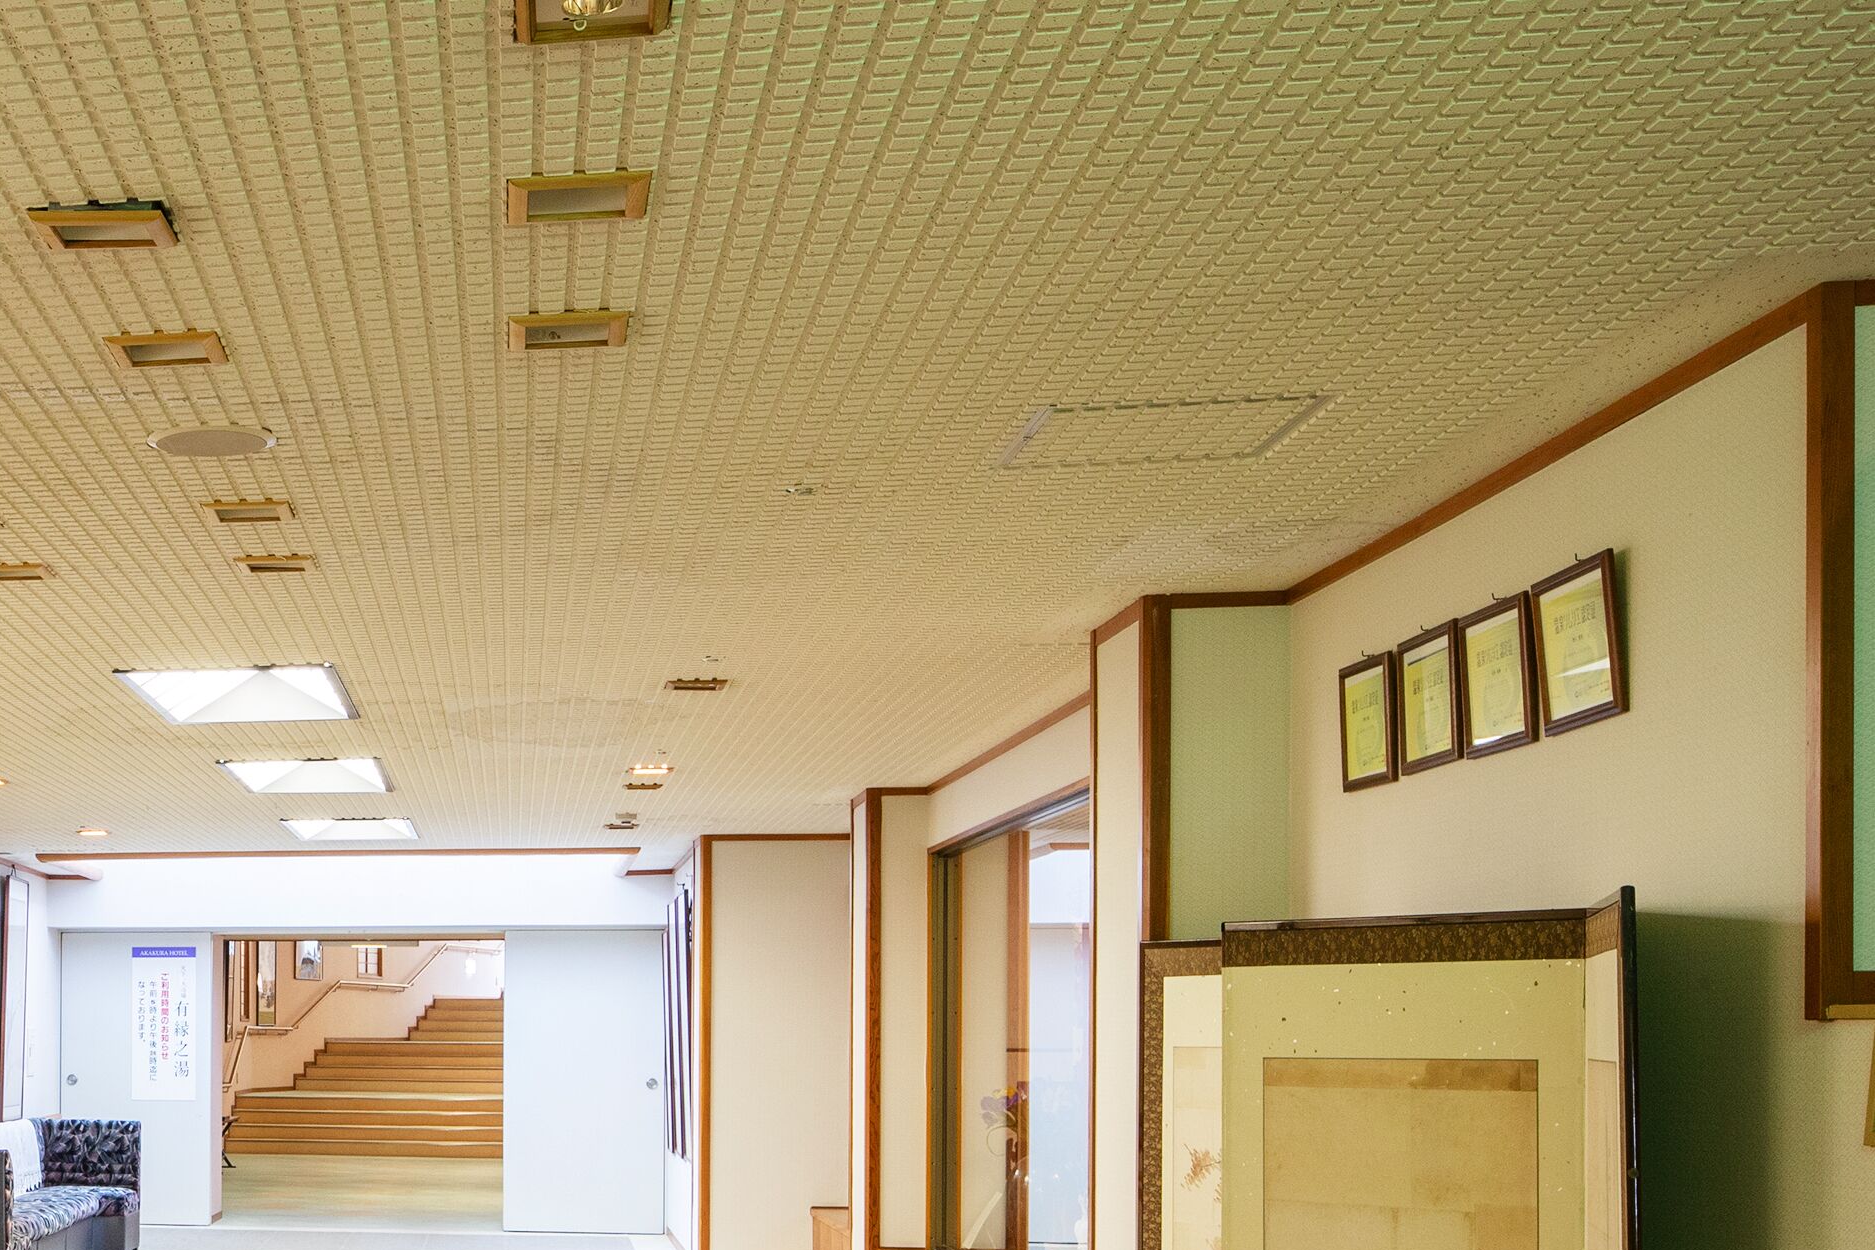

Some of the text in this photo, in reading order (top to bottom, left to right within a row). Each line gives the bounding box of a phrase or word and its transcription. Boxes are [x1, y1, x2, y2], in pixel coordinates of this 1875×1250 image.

[161, 971, 169, 1060] ご利用時間のお知らせ
